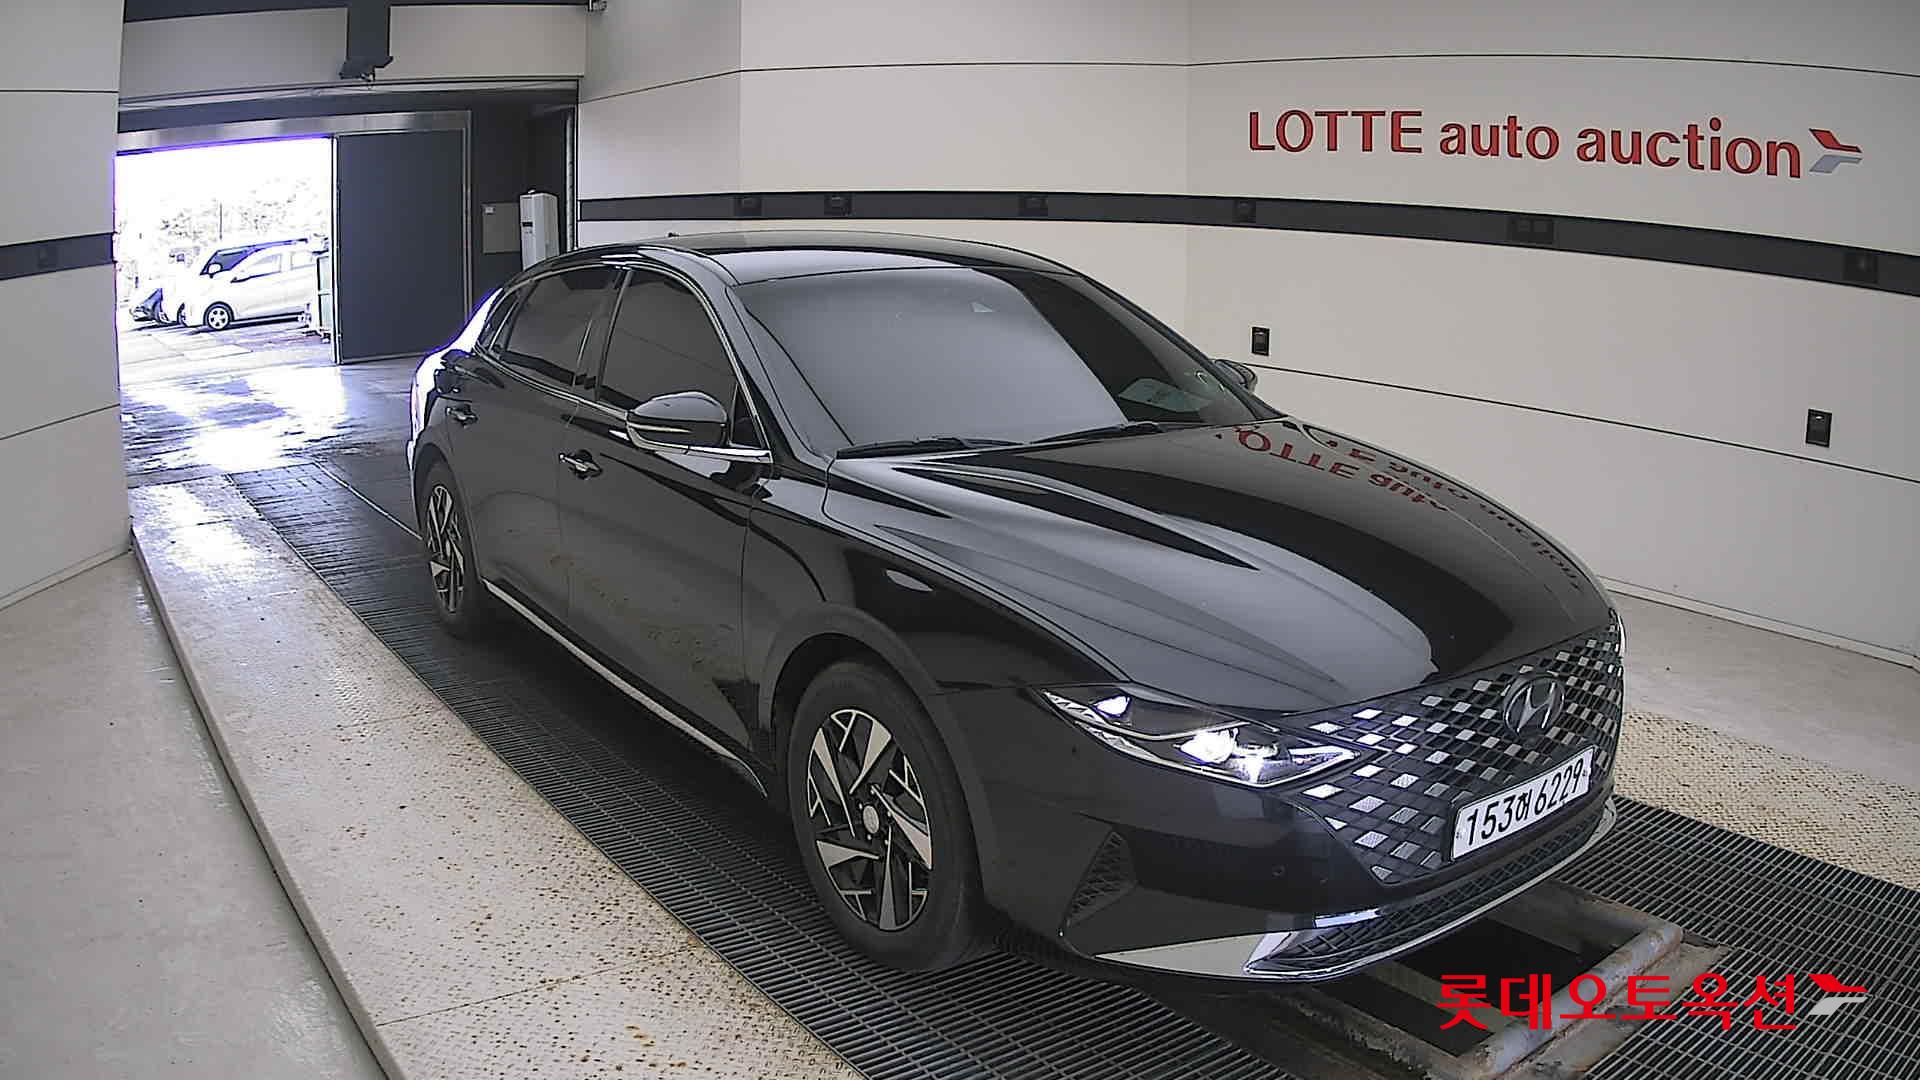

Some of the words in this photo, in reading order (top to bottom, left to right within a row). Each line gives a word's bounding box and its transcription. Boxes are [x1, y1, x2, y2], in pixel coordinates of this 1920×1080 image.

[1248, 110, 1423, 154] LOTTE
[1439, 115, 1560, 160] auto
[1576, 116, 1801, 179] auction
